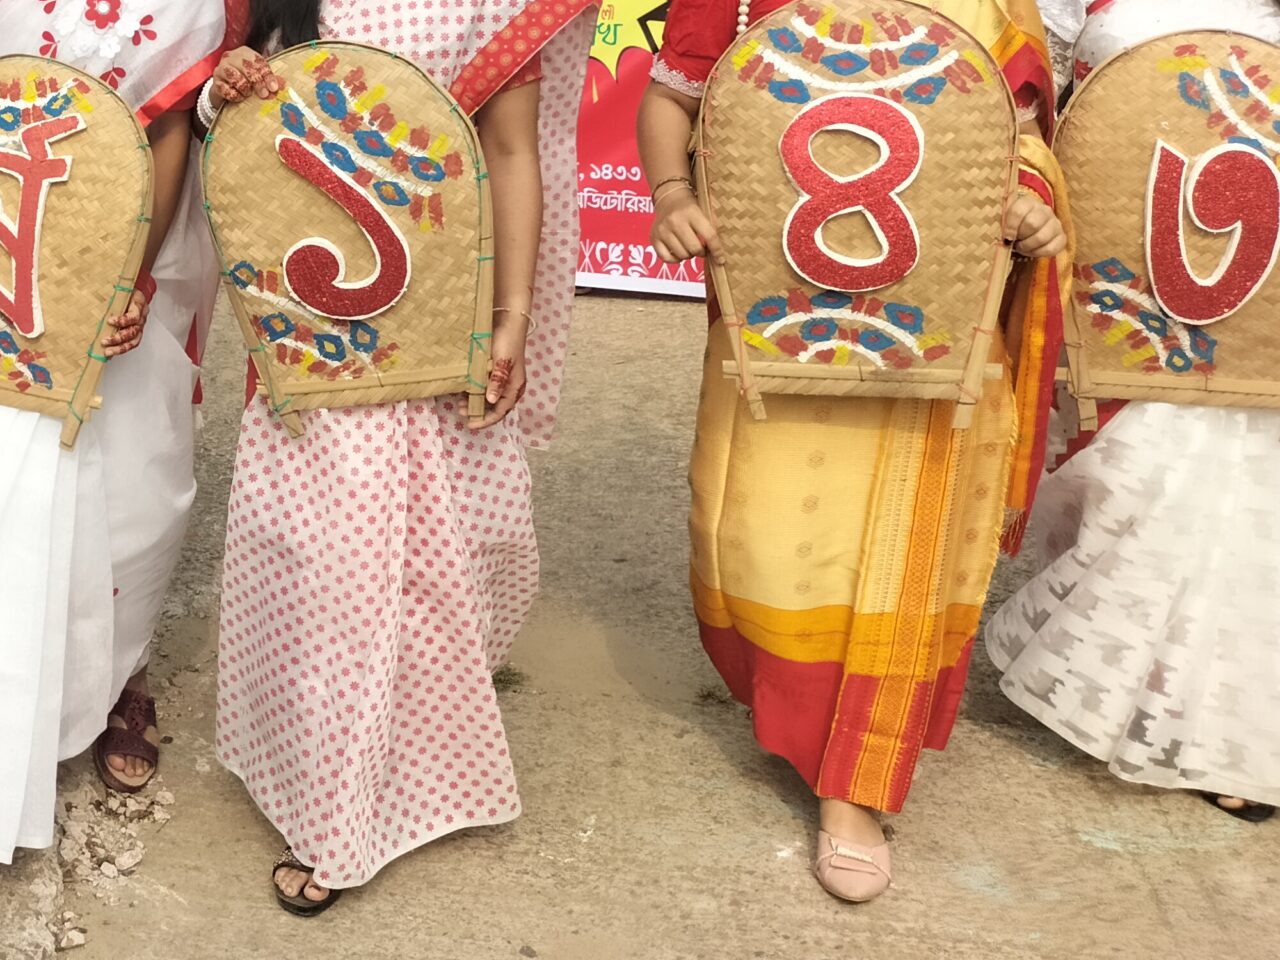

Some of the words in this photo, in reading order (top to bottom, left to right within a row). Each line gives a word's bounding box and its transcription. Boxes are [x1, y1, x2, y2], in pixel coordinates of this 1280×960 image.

[274, 133, 412, 321] ১
[577, 187, 654, 213] ডিটোরিয়া
[589, 163, 641, 182] ১৪৩৩
[778, 91, 925, 292] ৪
[1144, 138, 1280, 325] ৩
